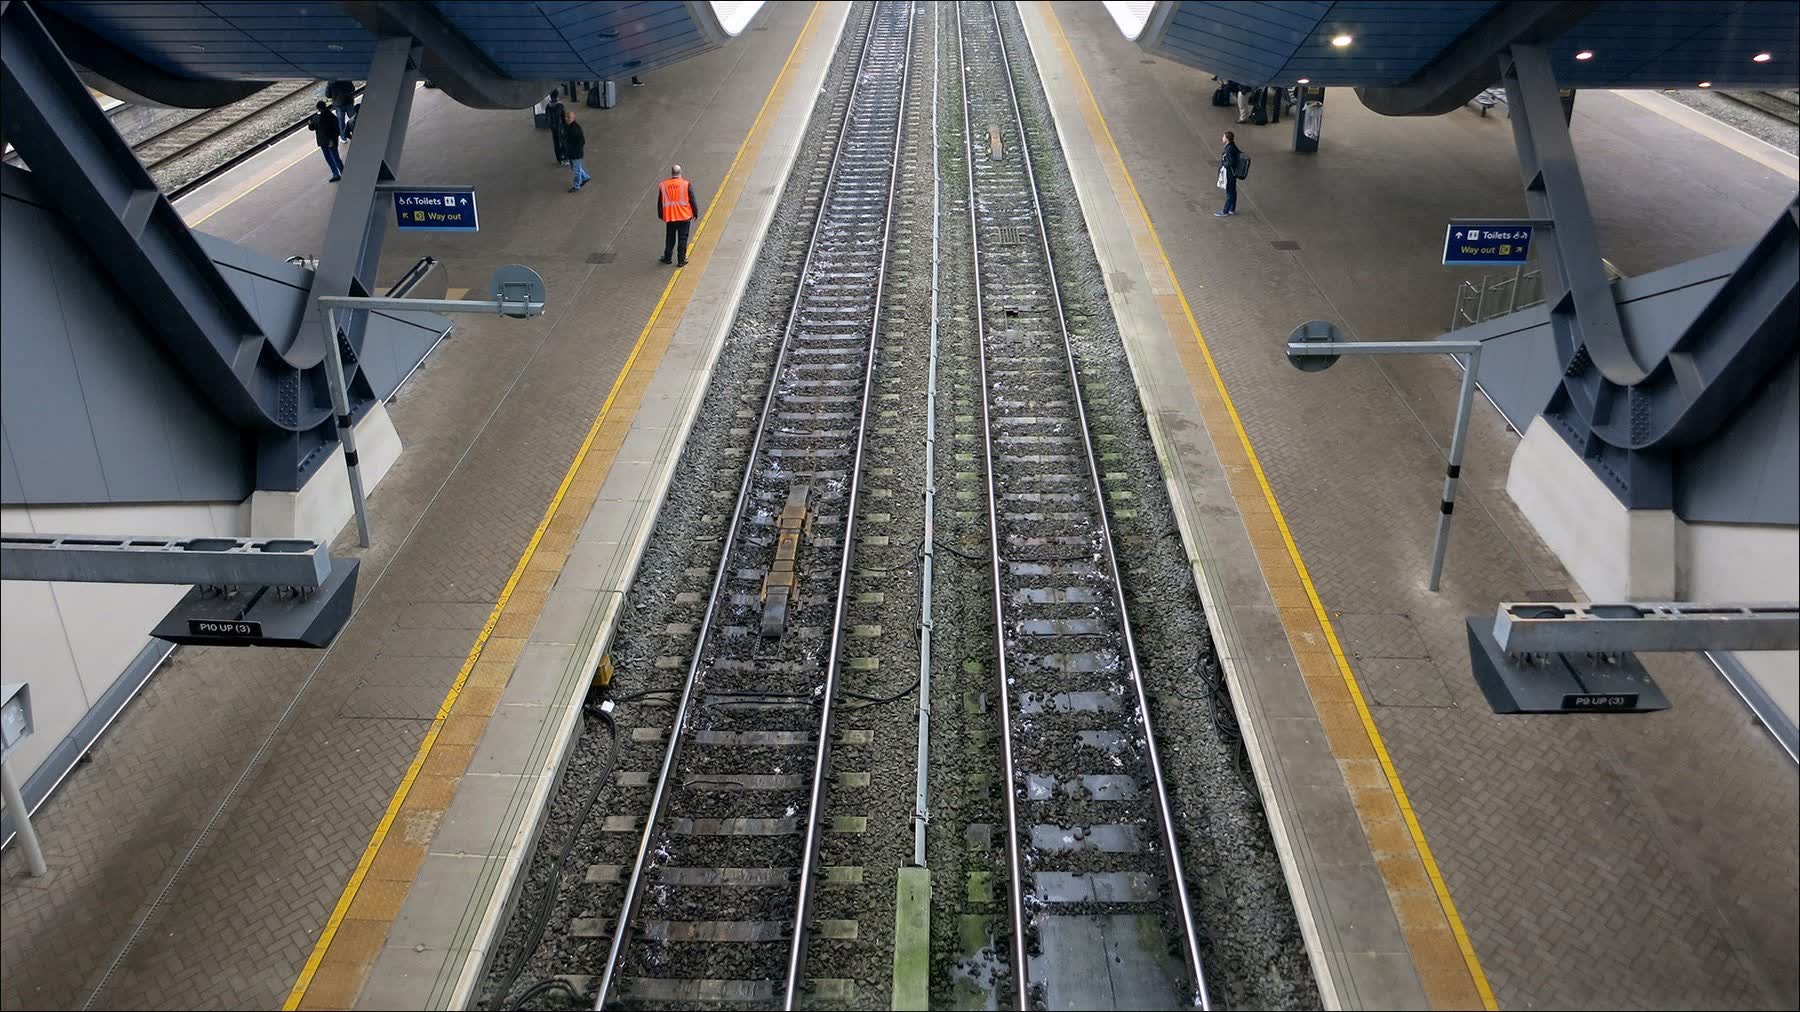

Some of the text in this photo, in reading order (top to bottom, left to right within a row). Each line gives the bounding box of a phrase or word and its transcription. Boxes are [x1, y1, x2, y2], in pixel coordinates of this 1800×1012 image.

[413, 197, 442, 205] Toilets
[428, 212, 446, 221] Way
[1483, 231, 1511, 239] Toilets
[1461, 246, 1479, 255] Way
[200, 623, 251, 633] P10 UP (3)
[1575, 697, 1624, 705] P9 UP (3)
